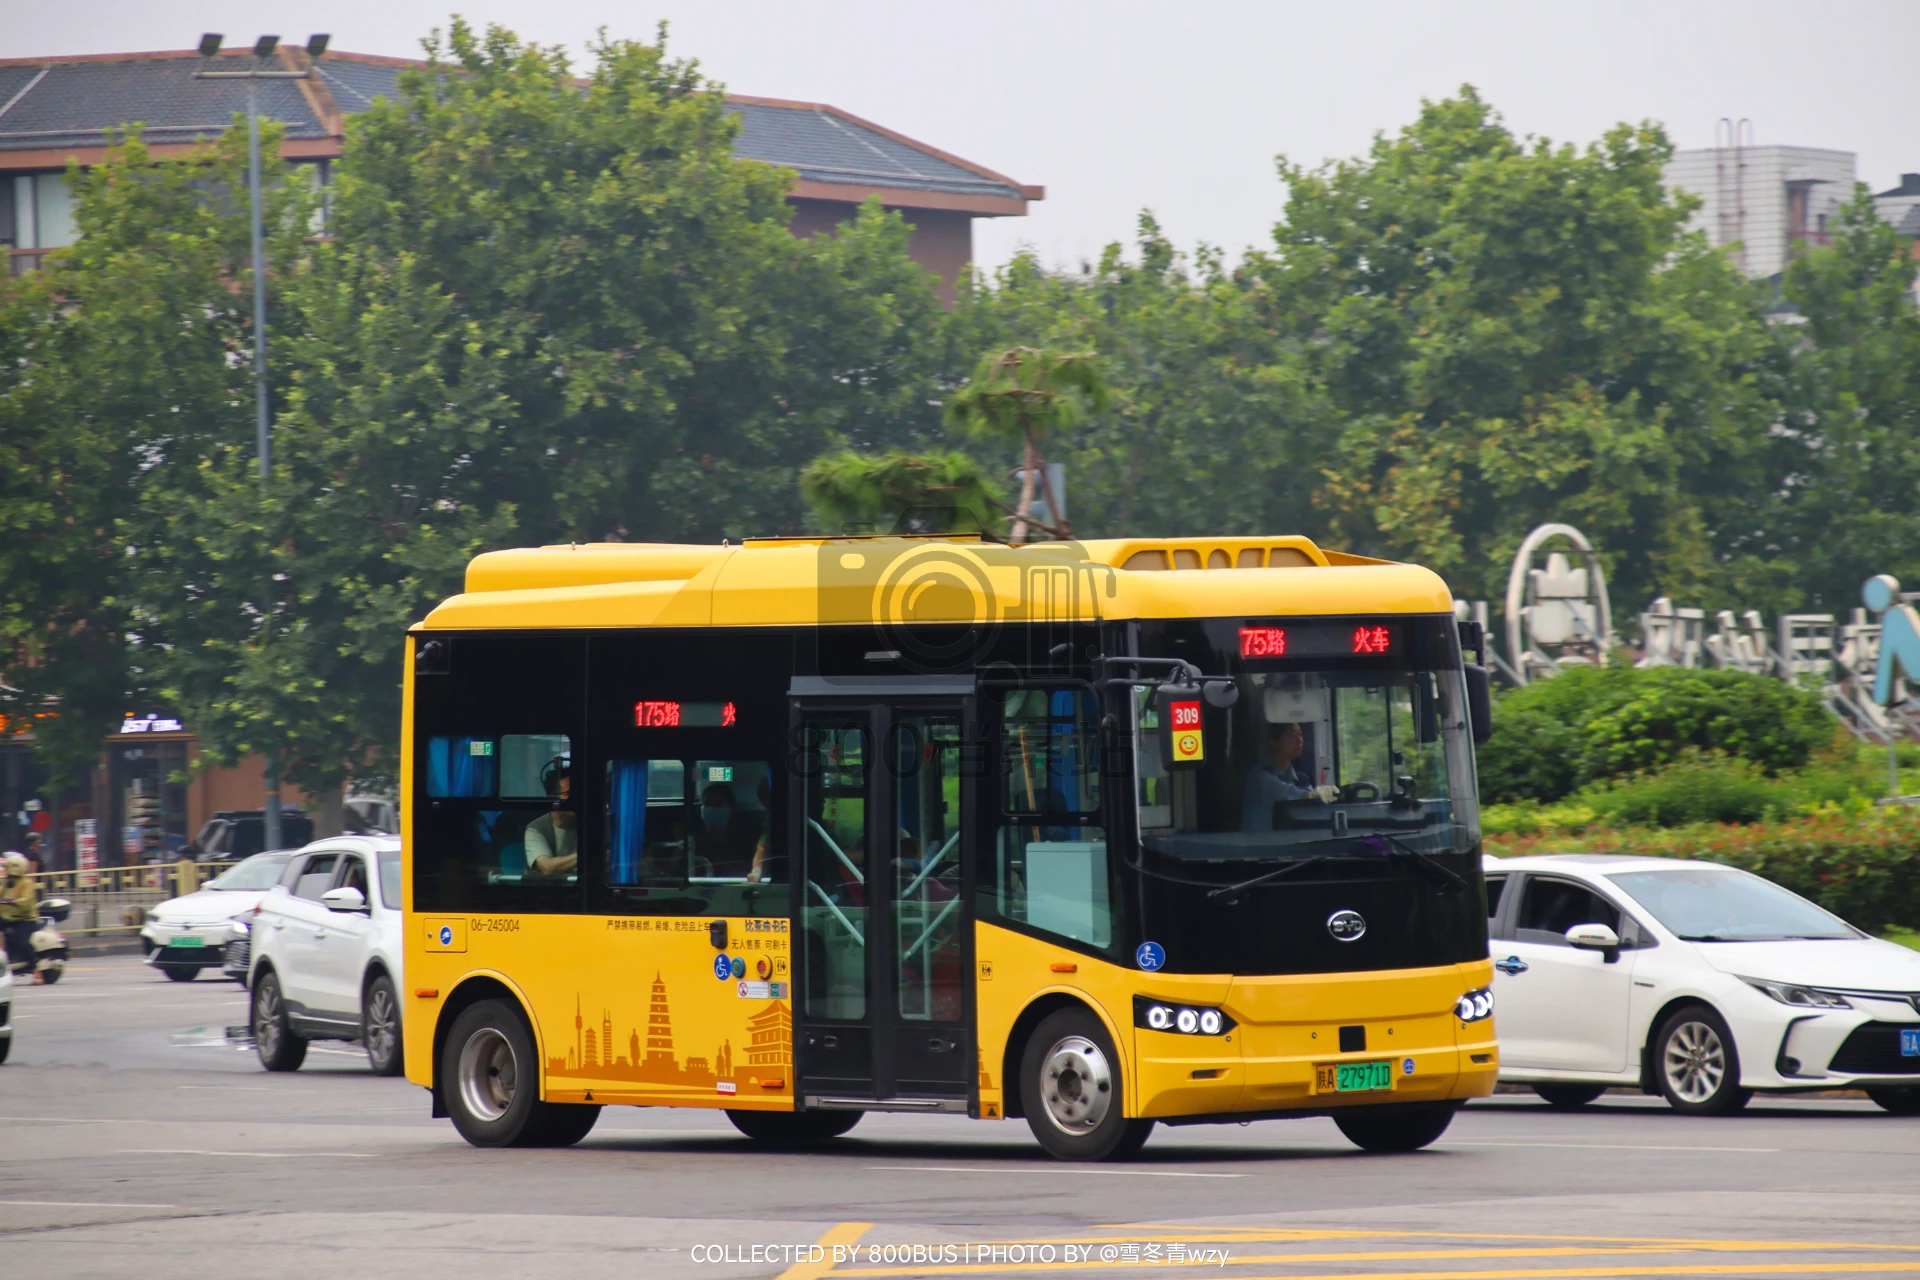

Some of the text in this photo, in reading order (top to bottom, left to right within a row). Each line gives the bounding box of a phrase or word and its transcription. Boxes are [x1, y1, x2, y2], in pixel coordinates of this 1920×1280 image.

[1239, 626, 1390, 656] 75路 火车
[634, 701, 680, 727] 175路
[1175, 707, 1199, 725] 309
[471, 918, 520, 932] 06-245004
[731, 939, 788, 951] 无人售票 可刷卡
